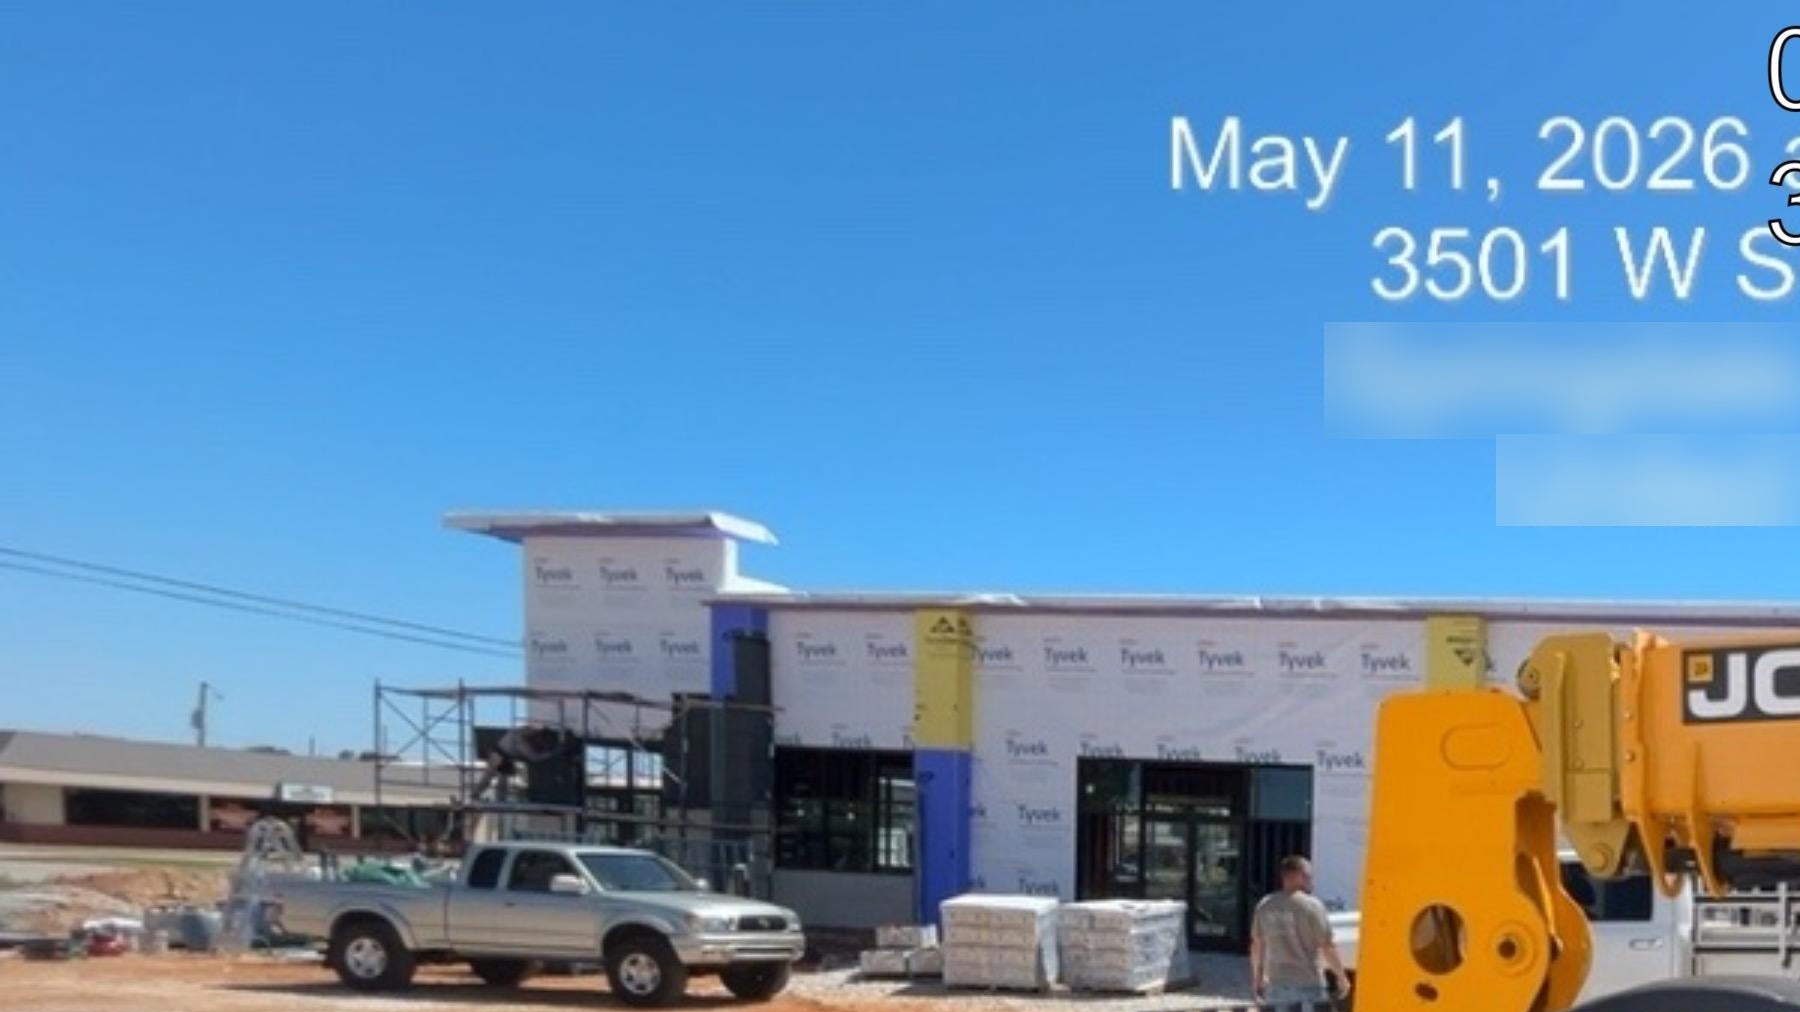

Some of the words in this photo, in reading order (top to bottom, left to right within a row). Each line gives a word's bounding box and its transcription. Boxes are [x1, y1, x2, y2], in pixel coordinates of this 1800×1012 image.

[599, 566, 638, 583] Tyvek
[664, 566, 704, 584] Tyvek
[796, 641, 837, 658] Tyvek
[866, 642, 908, 659] Tyvek
[1043, 646, 1088, 665] Tyvek
[1120, 648, 1165, 666] Tyvek
[1198, 650, 1244, 669] Tyvek
[1279, 651, 1325, 670] Tyvek
[1360, 653, 1411, 672] Tyvek
[1004, 739, 1048, 757] Tyvek
[1316, 750, 1366, 770] Tyvek
[1016, 804, 1061, 822] Tyvek
